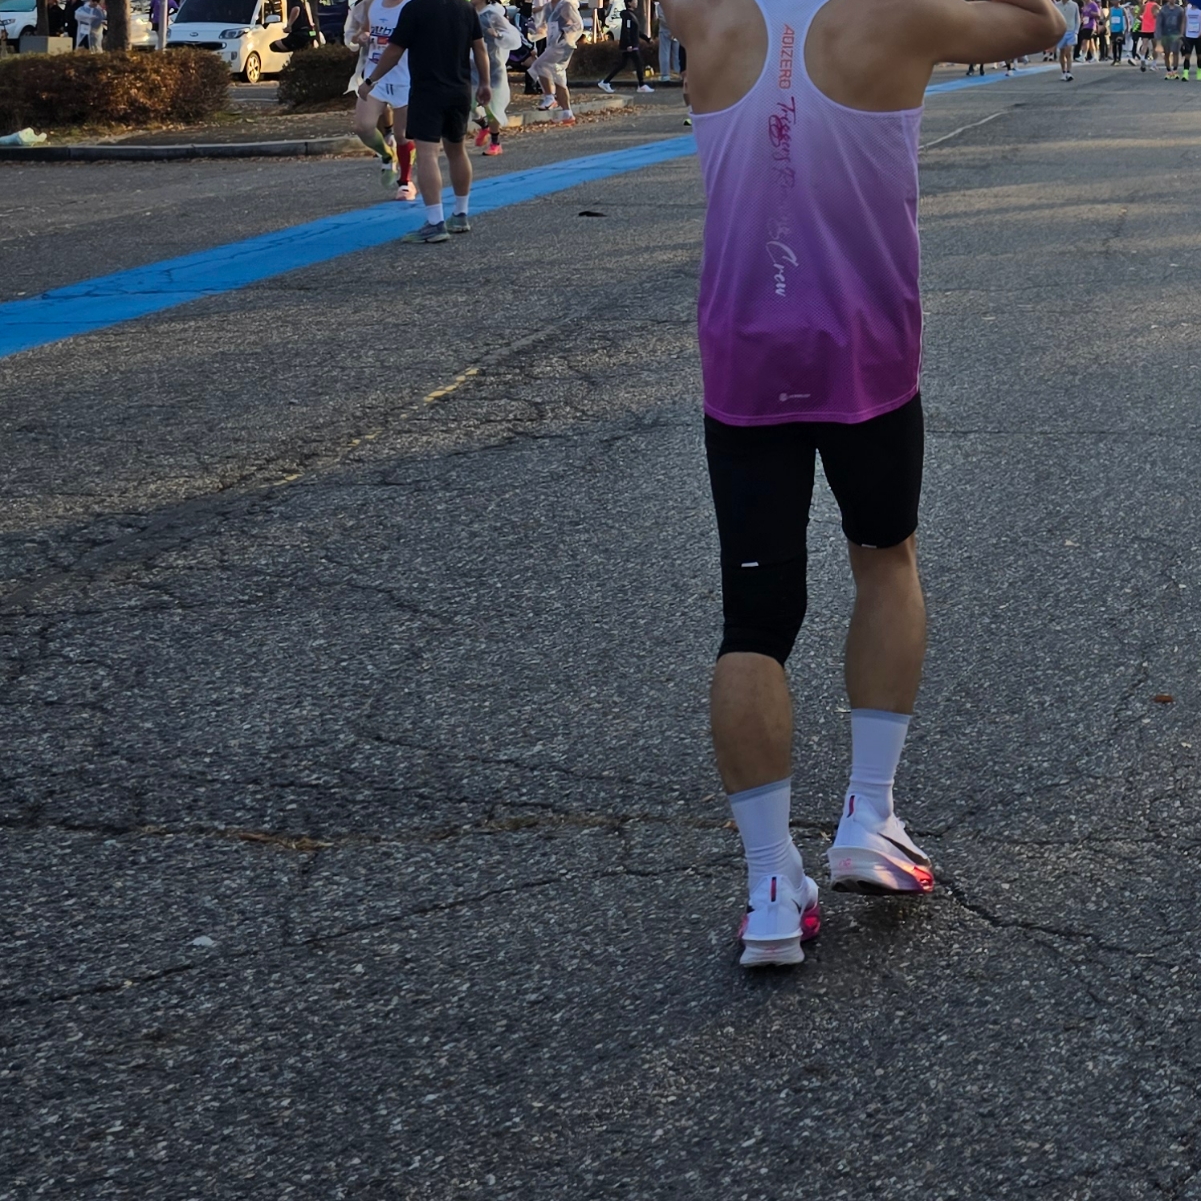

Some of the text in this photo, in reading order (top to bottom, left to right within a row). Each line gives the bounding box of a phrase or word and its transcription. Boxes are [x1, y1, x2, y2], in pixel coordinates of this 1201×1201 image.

[778, 23, 795, 90] ADIZERO
[766, 96, 799, 297] Triggers Ruing Crew
